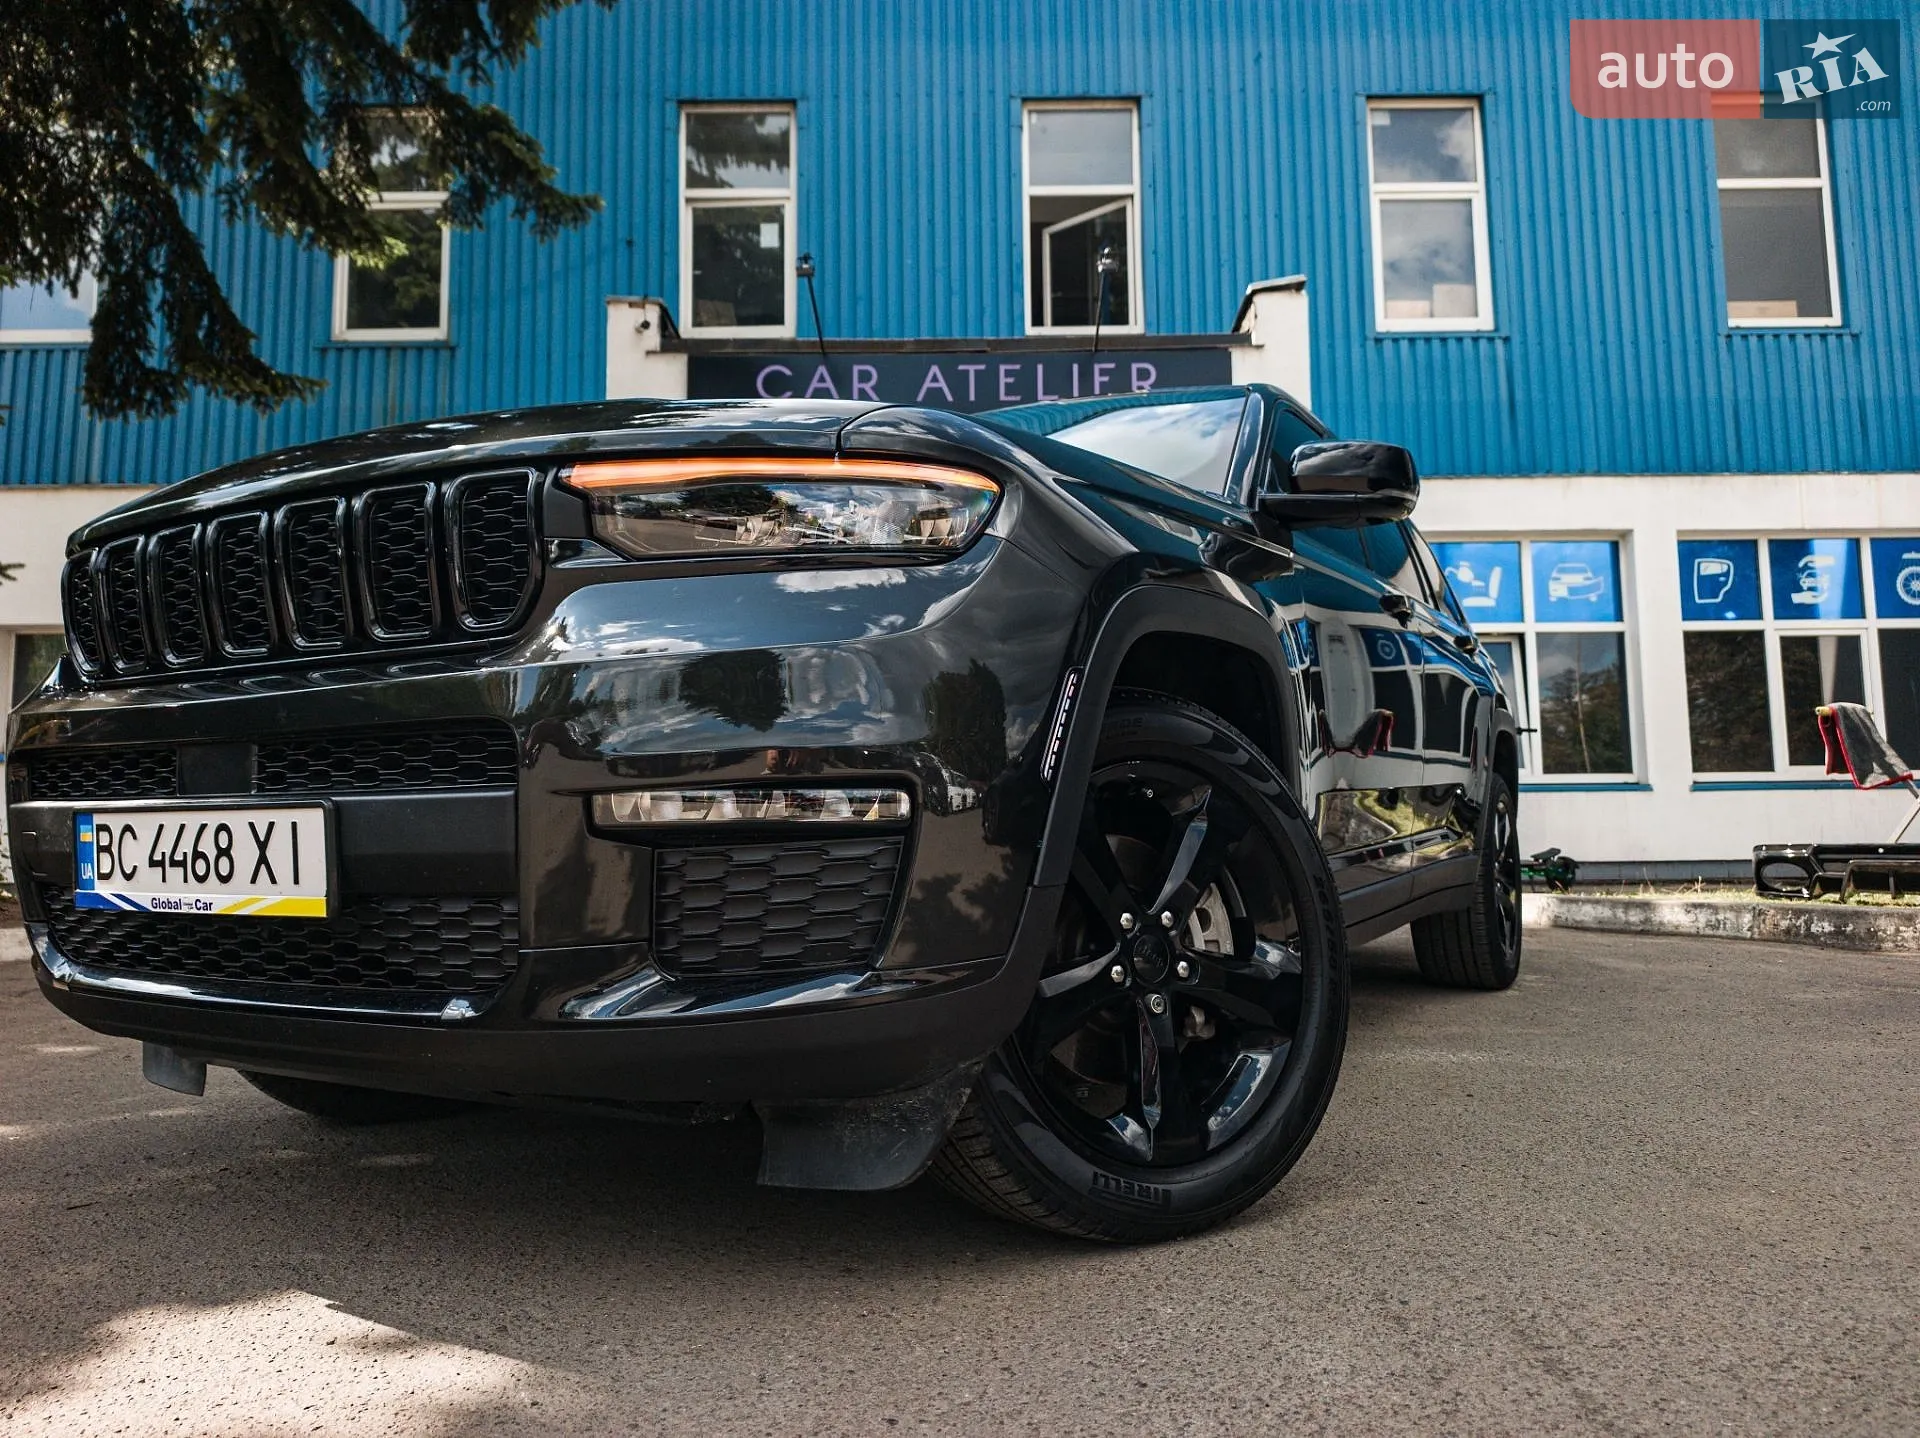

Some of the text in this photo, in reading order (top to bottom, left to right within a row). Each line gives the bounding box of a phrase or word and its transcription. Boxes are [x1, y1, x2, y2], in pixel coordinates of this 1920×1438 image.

[755, 361, 1158, 402] CAR ATELIER
[96, 822, 138, 882] BC
[148, 821, 235, 884] 4468
[81, 862, 94, 880] UA
[150, 897, 183, 911] Global
[194, 898, 214, 912] Car
